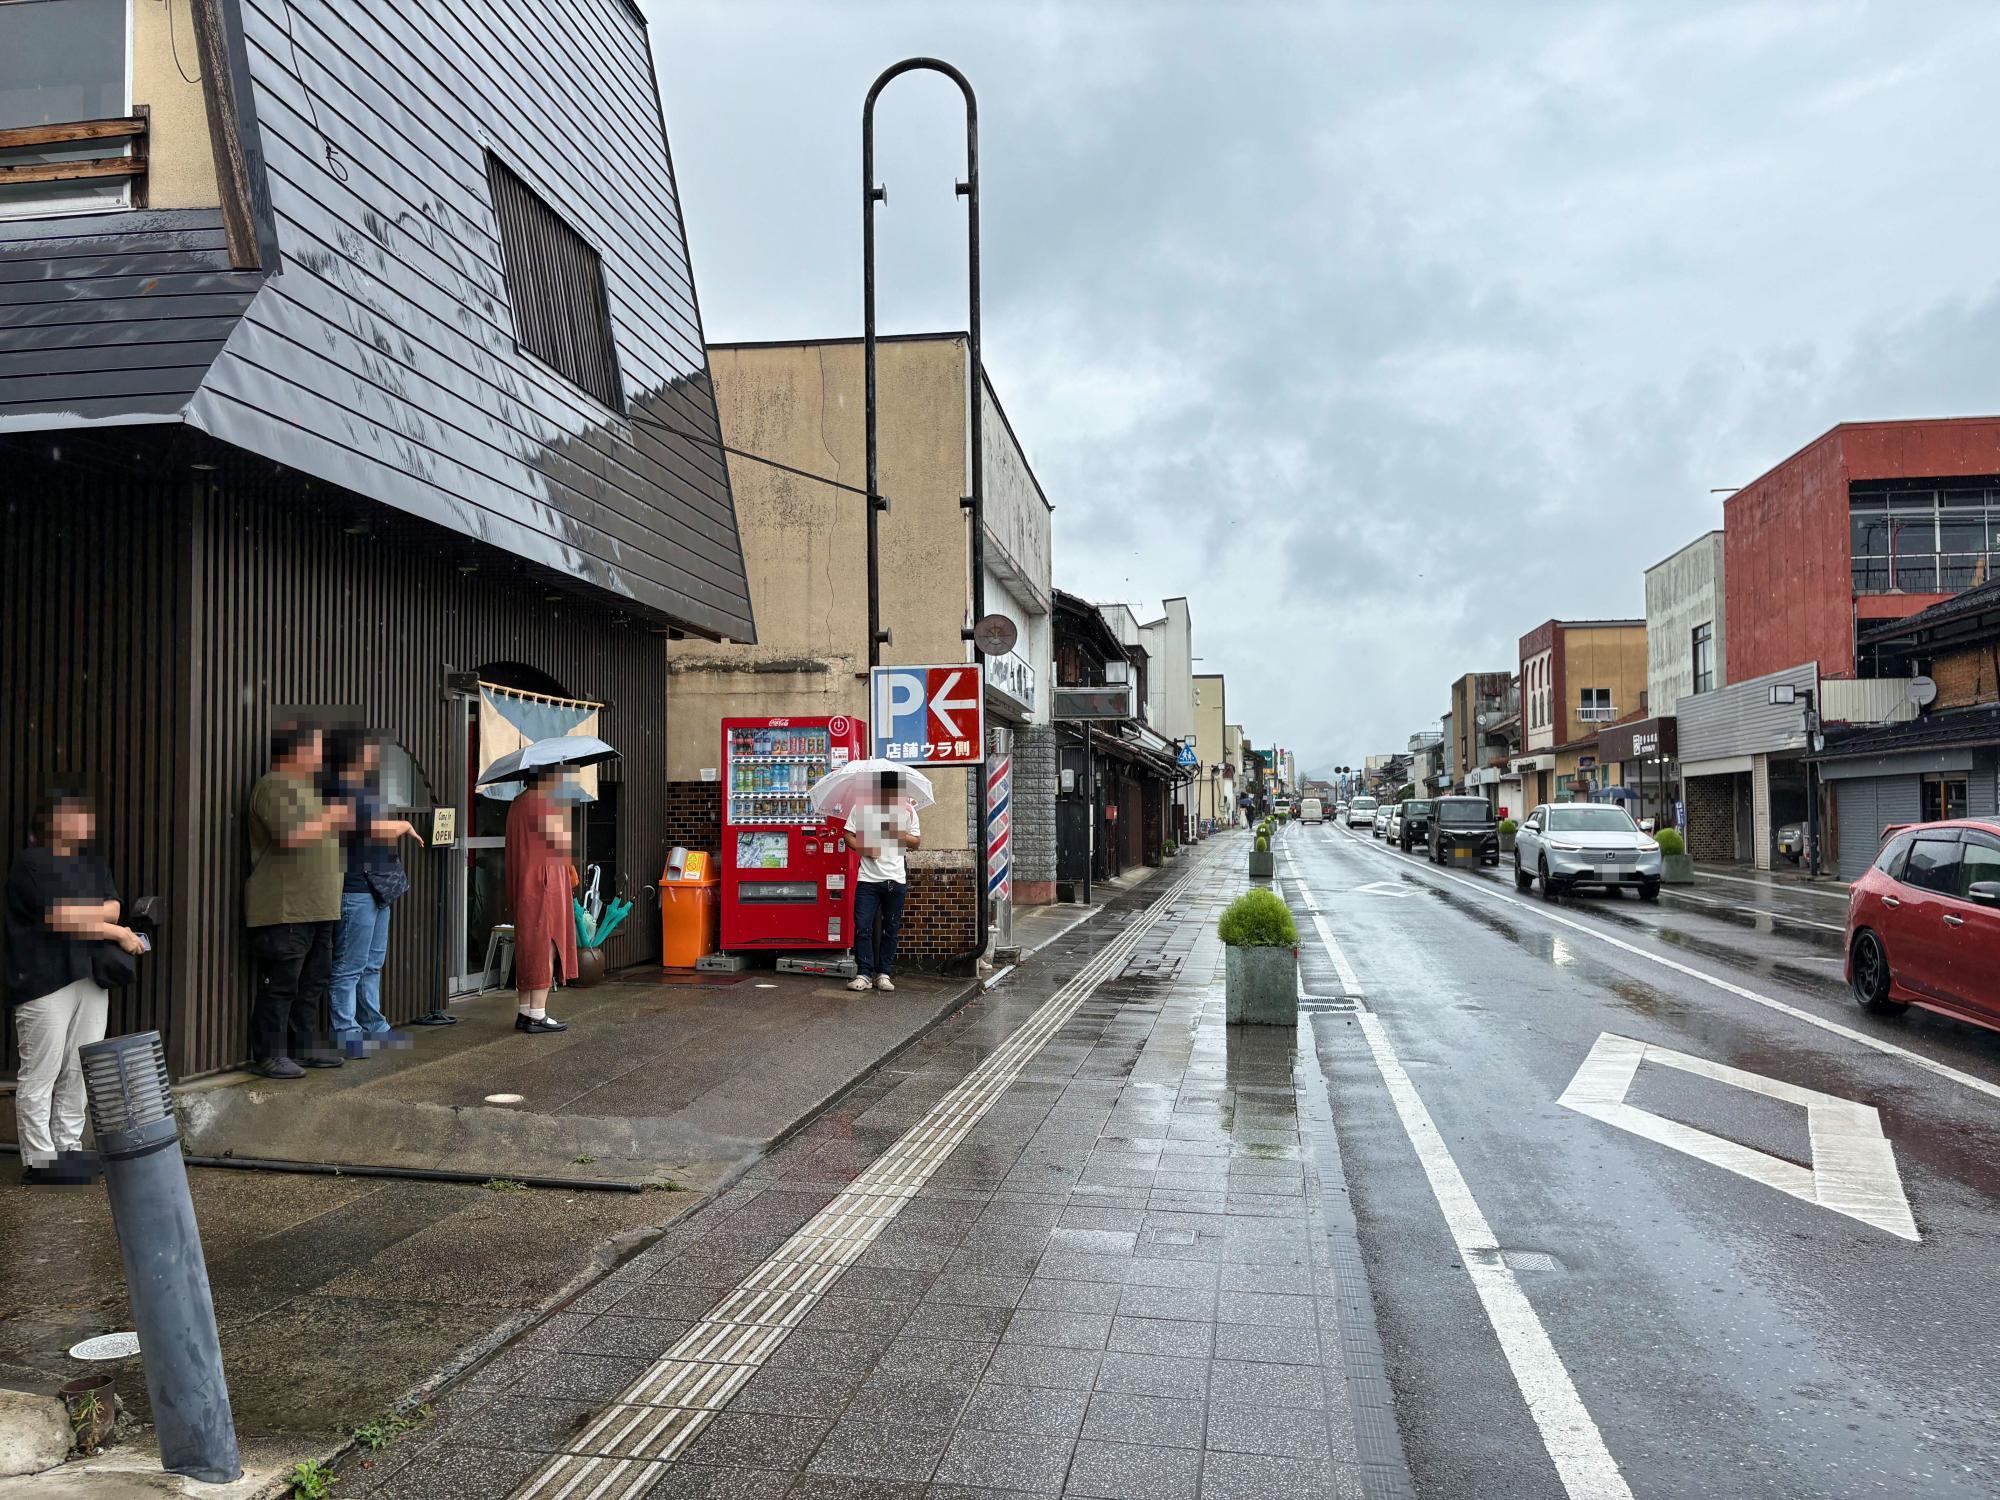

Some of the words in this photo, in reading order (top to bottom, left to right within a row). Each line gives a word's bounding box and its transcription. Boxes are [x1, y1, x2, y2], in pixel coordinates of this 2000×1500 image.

[877, 673, 925, 738] P
[886, 740, 970, 759] 店舗ウラ側
[435, 830, 452, 841] OPEN
